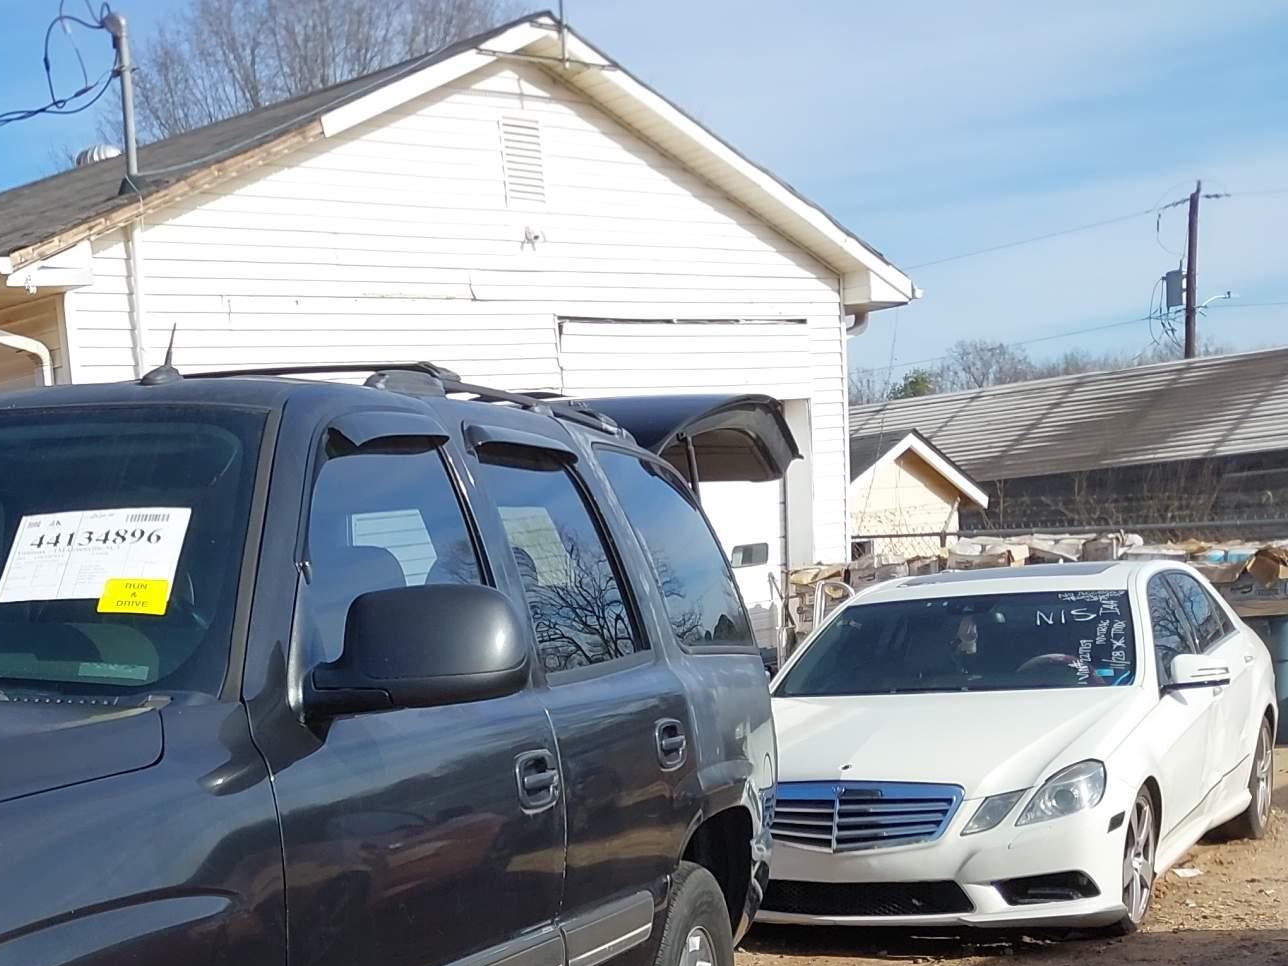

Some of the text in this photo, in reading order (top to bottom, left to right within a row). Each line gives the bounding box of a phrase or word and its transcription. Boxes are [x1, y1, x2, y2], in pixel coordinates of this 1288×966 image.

[29, 527, 164, 549] 44134896
[124, 582, 148, 590] RUN
[115, 599, 150, 608] DRIVE
